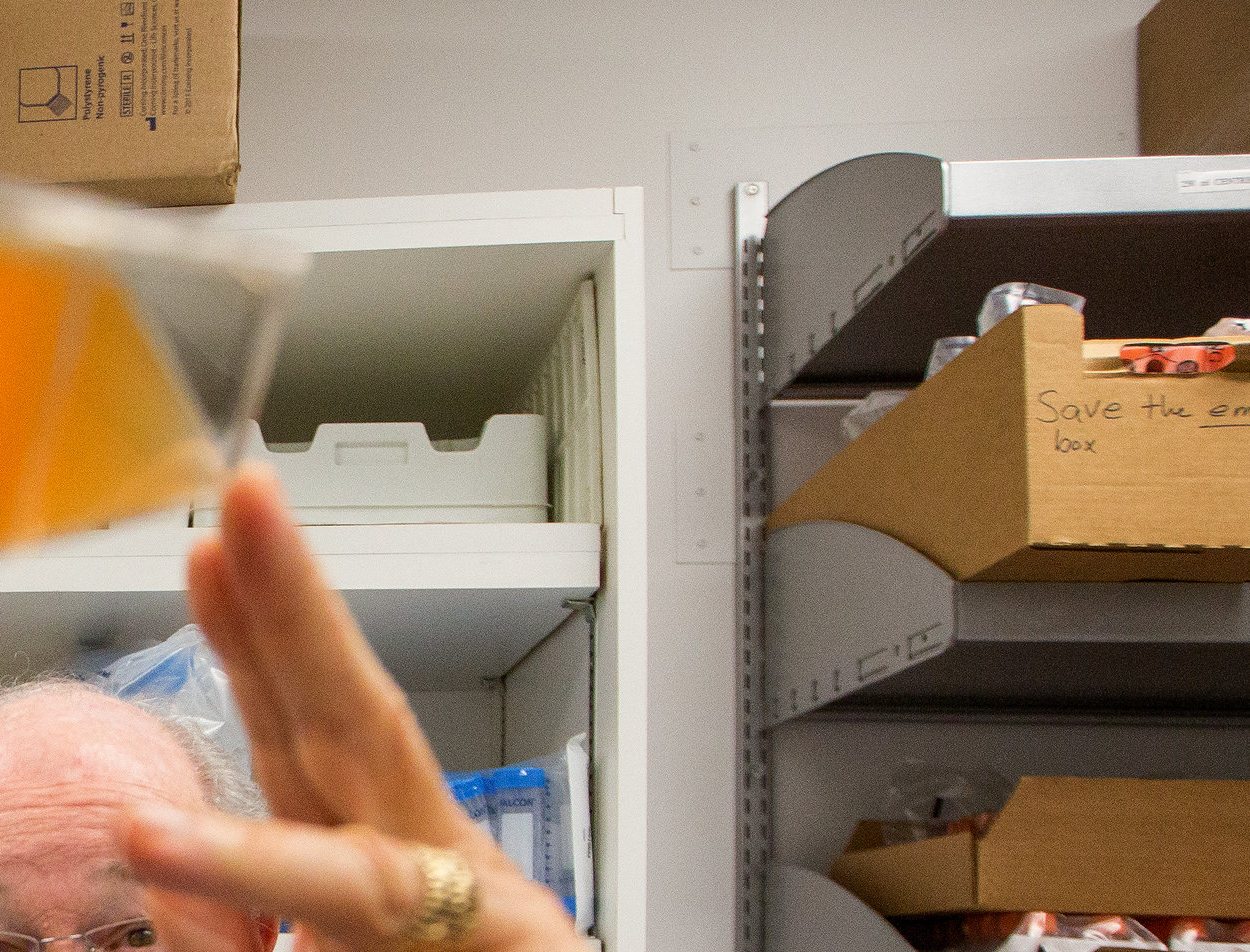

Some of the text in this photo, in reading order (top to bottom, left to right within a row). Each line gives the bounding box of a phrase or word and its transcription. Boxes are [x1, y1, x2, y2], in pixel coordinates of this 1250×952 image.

[82, 68, 93, 121] Polystyrene
[95, 55, 107, 120] Non-pyrogenic
[122, 86, 132, 115] STERILE
[1036, 389, 1123, 422] Save
[1141, 393, 1193, 419] the
[1054, 428, 1097, 454] box
